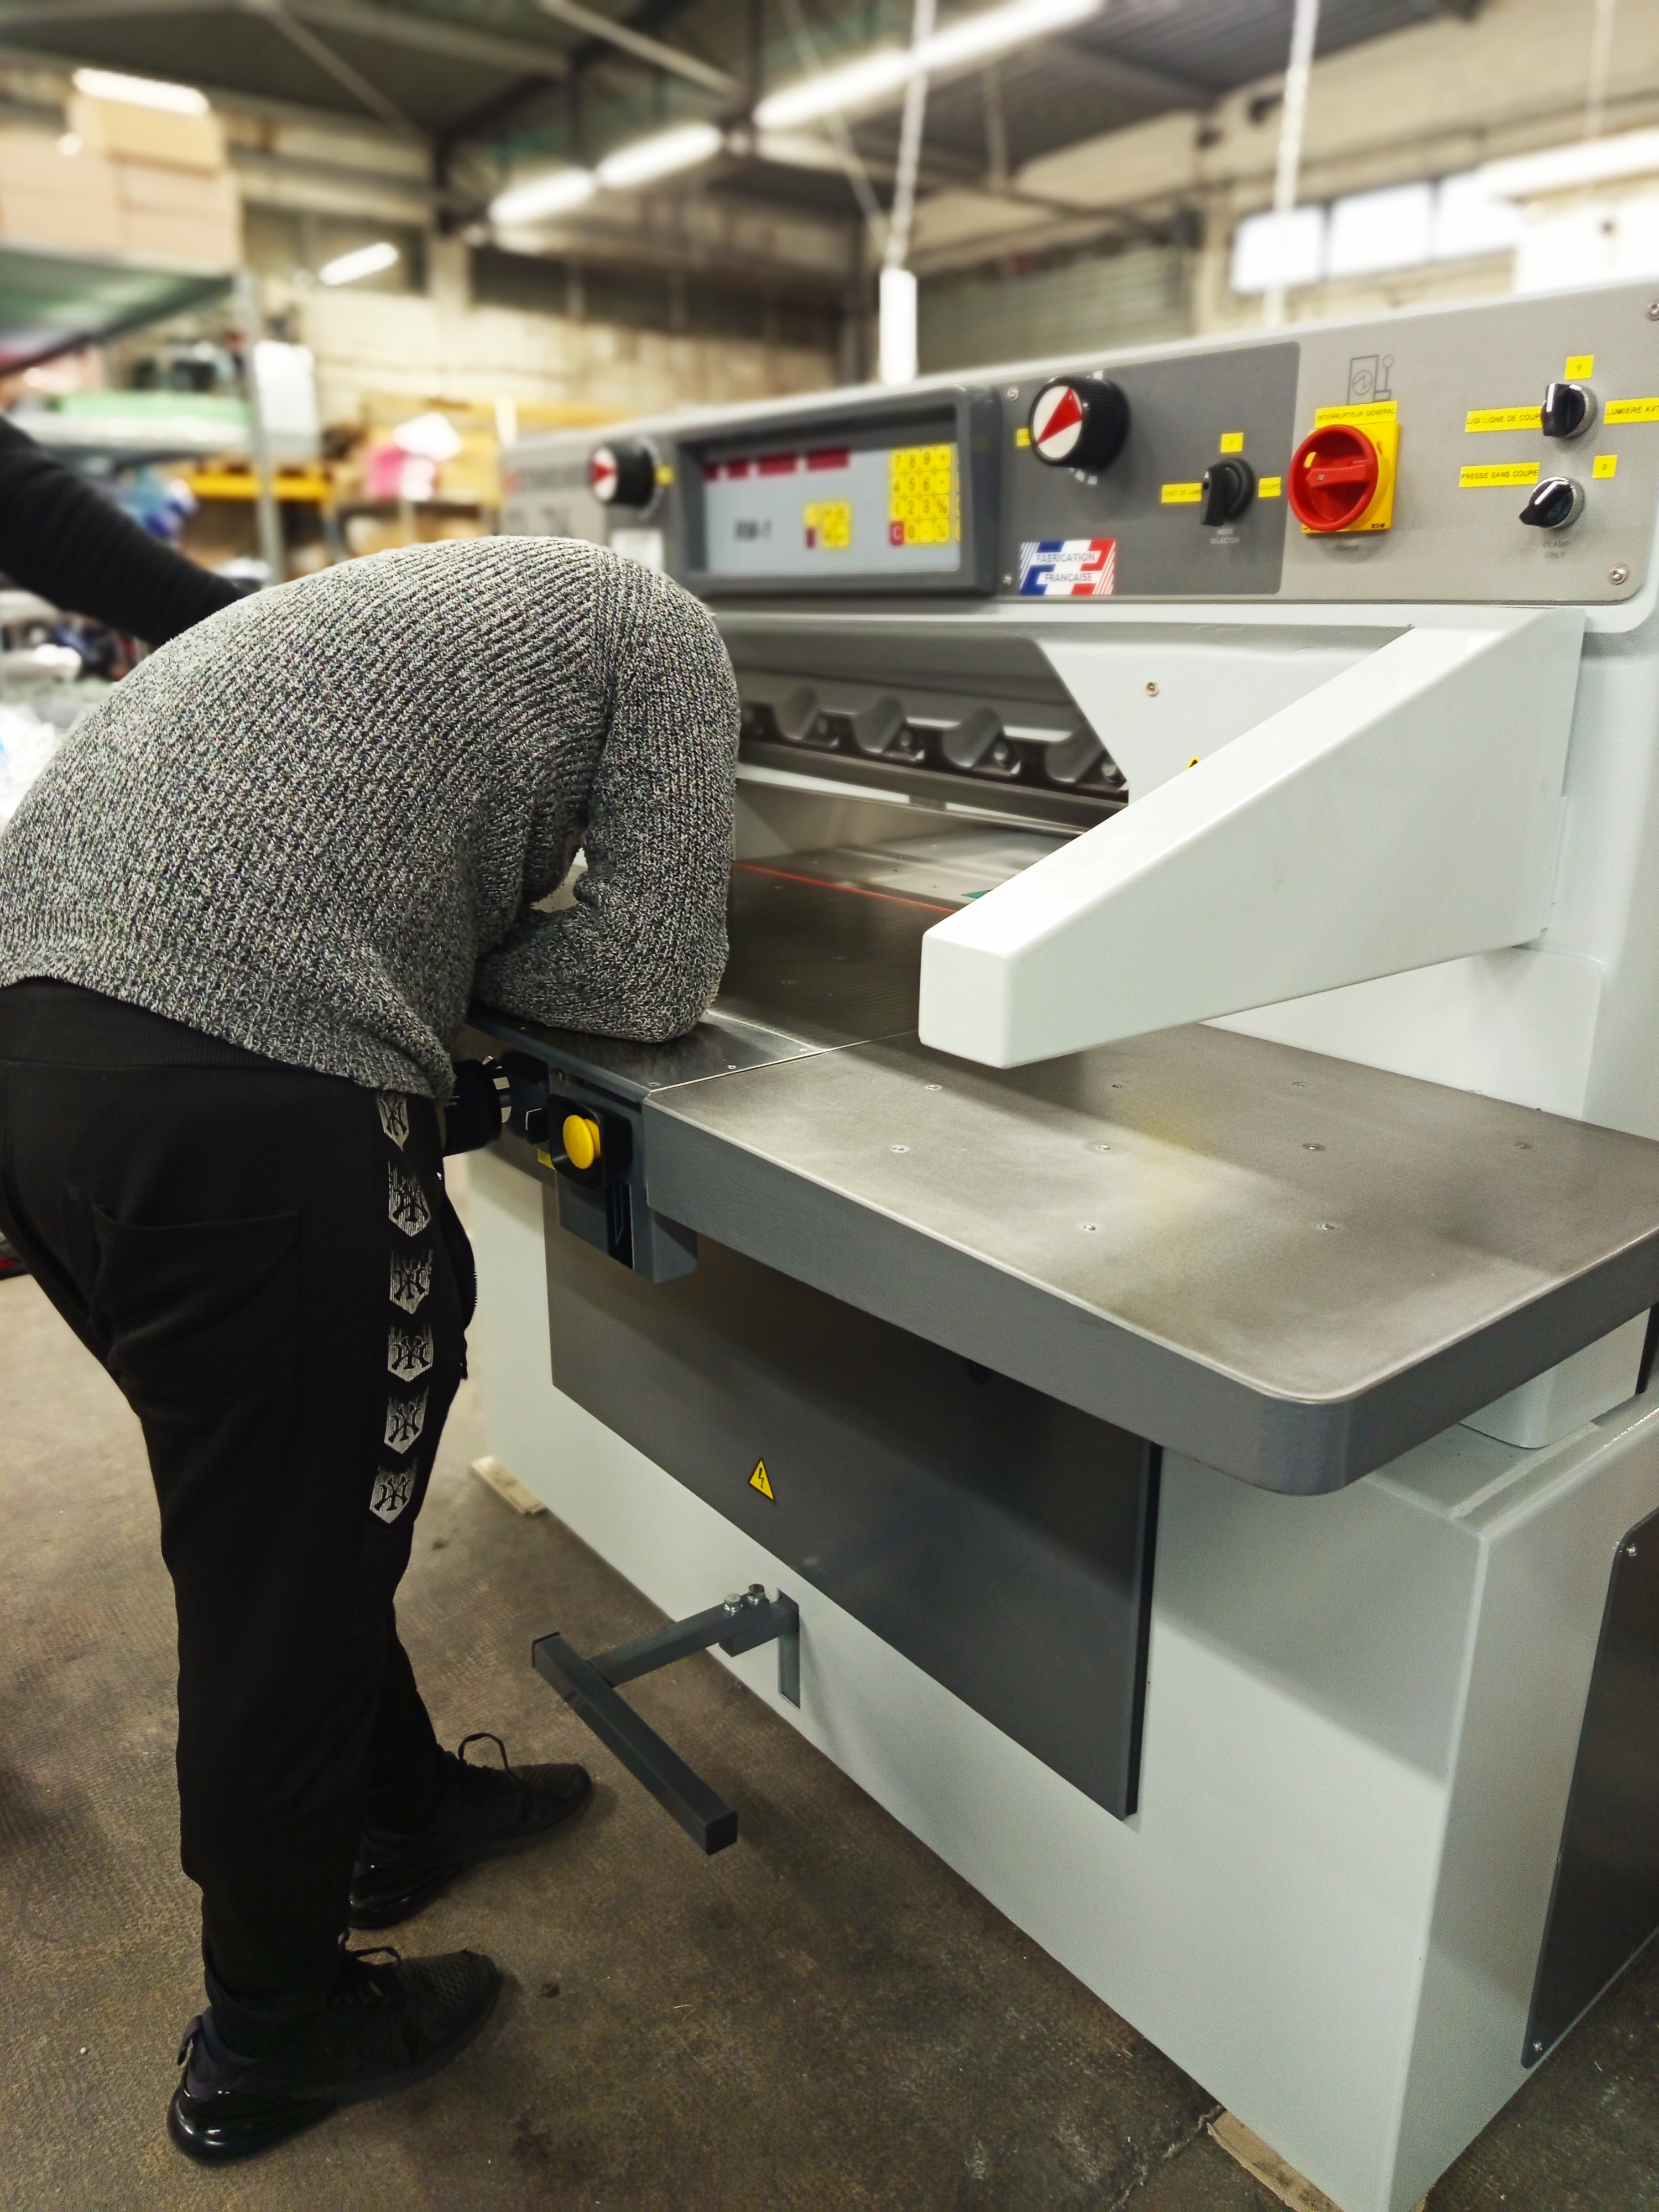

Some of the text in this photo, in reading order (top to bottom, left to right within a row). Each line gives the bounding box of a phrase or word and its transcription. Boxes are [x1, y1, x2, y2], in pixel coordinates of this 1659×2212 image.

[895, 451, 930, 469] 7 8 9
[894, 477, 930, 494] 4 5 6
[894, 503, 899, 516] 1
[907, 500, 915, 515] 2
[924, 499, 930, 514] 3
[893, 525, 915, 540] C 0
[1036, 552, 1095, 562] FABRICATION
[1045, 572, 1093, 583] FRANÇAISE
